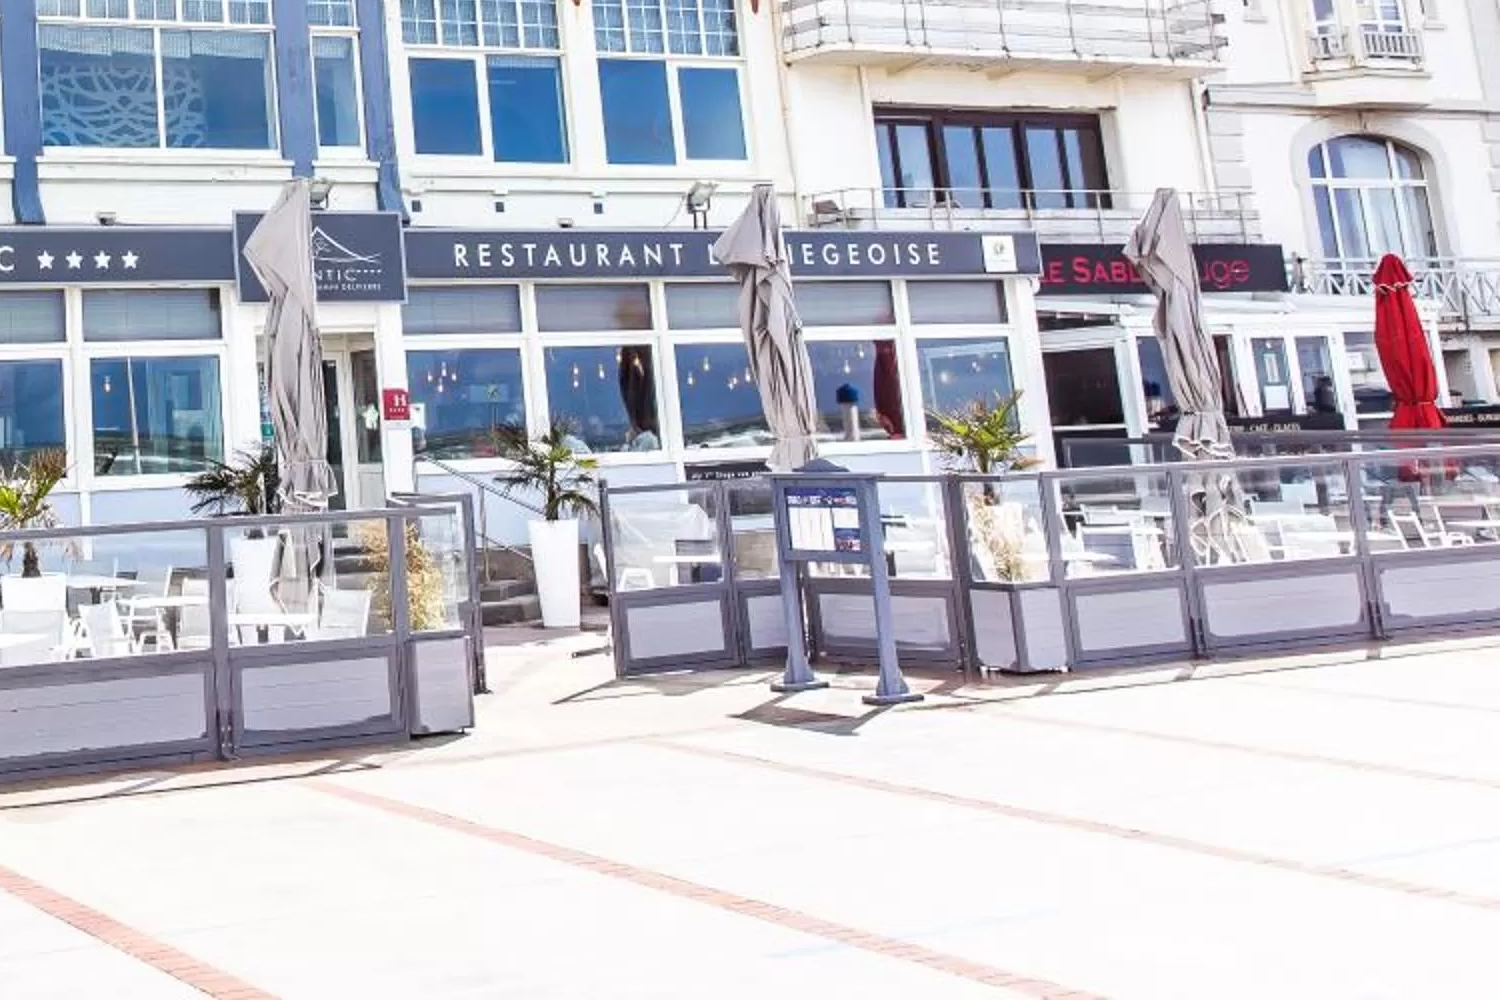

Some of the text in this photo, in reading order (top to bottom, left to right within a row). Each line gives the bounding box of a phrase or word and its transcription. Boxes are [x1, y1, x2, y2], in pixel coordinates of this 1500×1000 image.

[454, 243, 684, 268] RESTAURANT
[786, 243, 941, 266] IEGEOISE
[1071, 256, 1145, 284] SABL
